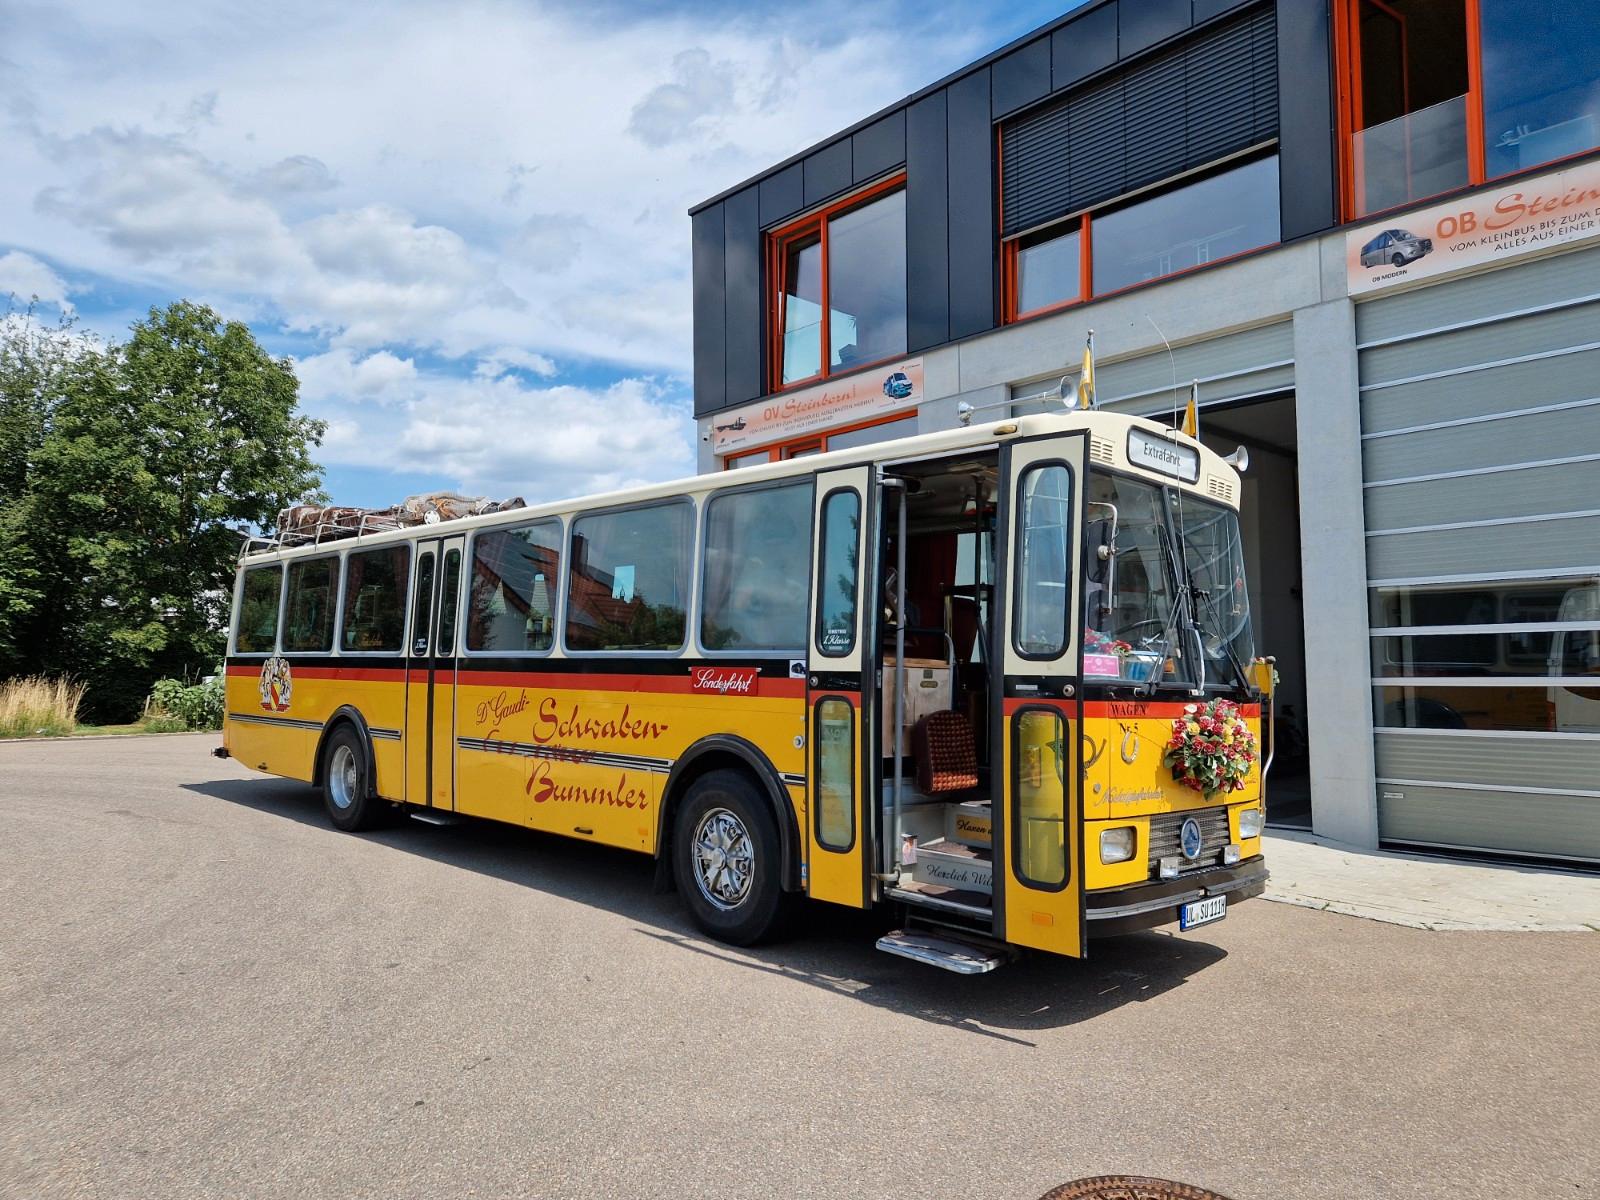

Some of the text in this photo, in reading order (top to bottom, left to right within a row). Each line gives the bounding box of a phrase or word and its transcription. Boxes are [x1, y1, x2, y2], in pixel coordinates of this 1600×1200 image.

[1436, 211, 1477, 239] OB
[1449, 240, 1477, 252] VOM
[1480, 224, 1535, 246] KLEINBUS
[1540, 218, 1556, 230] BIS
[1560, 211, 1590, 225] ZUM
[1494, 220, 1594, 252] ALLES AUS EINER
[764, 405, 779, 421] OV
[1143, 442, 1181, 467] Extrafahrt
[694, 668, 754, 692] Sonderfahrt
[1110, 703, 1148, 717] WAGEN
[526, 760, 648, 810] Bummler
